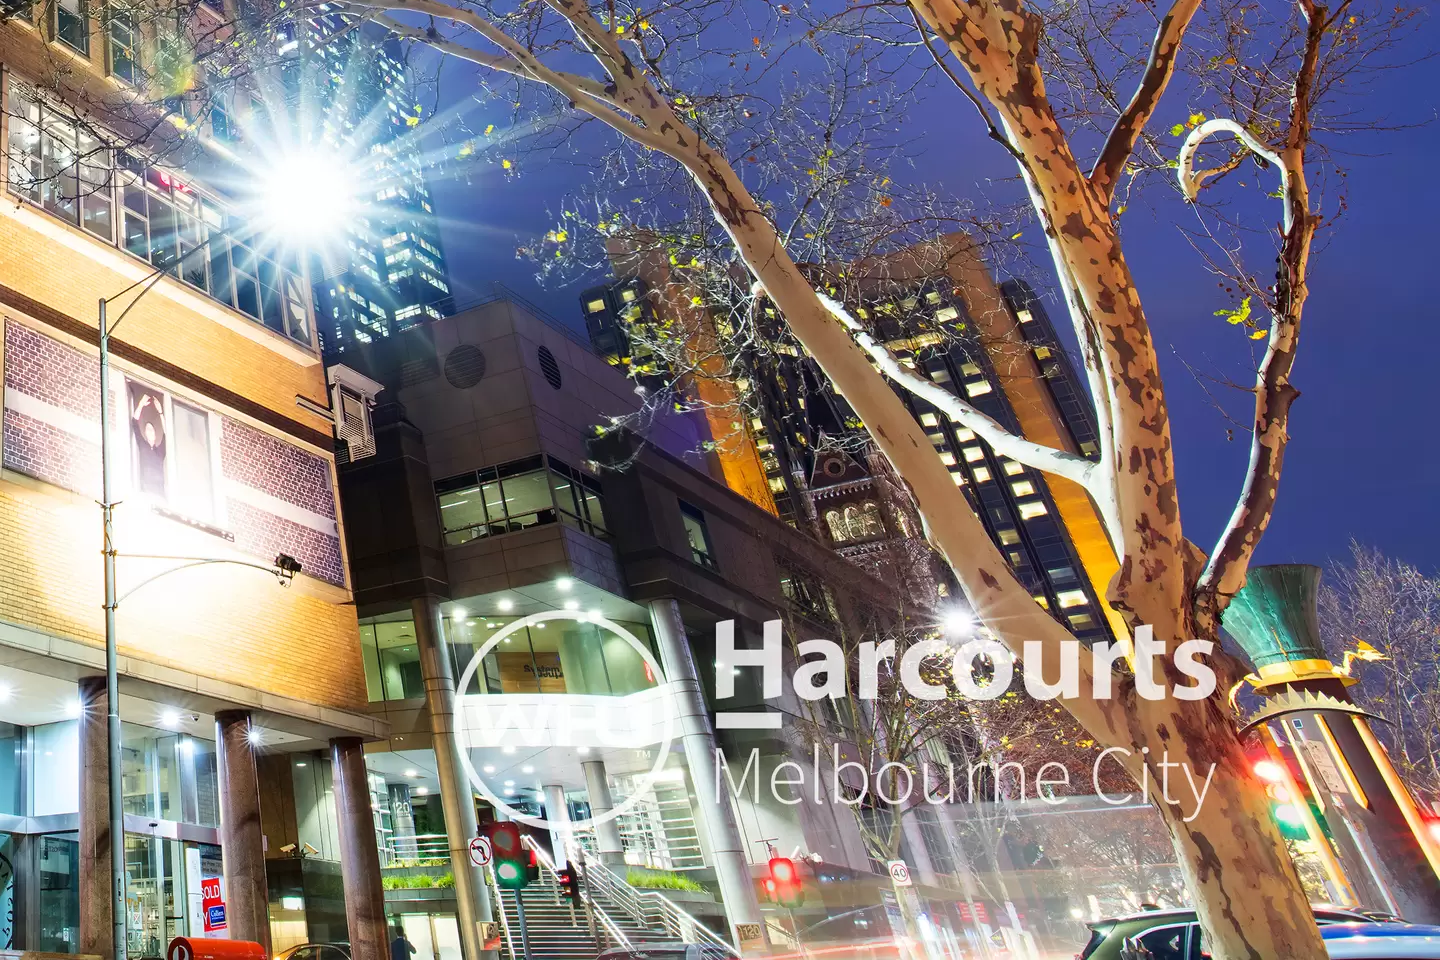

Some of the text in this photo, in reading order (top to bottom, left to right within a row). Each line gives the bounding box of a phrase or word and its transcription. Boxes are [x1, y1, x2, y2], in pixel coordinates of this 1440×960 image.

[893, 868, 907, 878] 40
[201, 884, 220, 900] SOLD
[743, 924, 761, 936] 120
